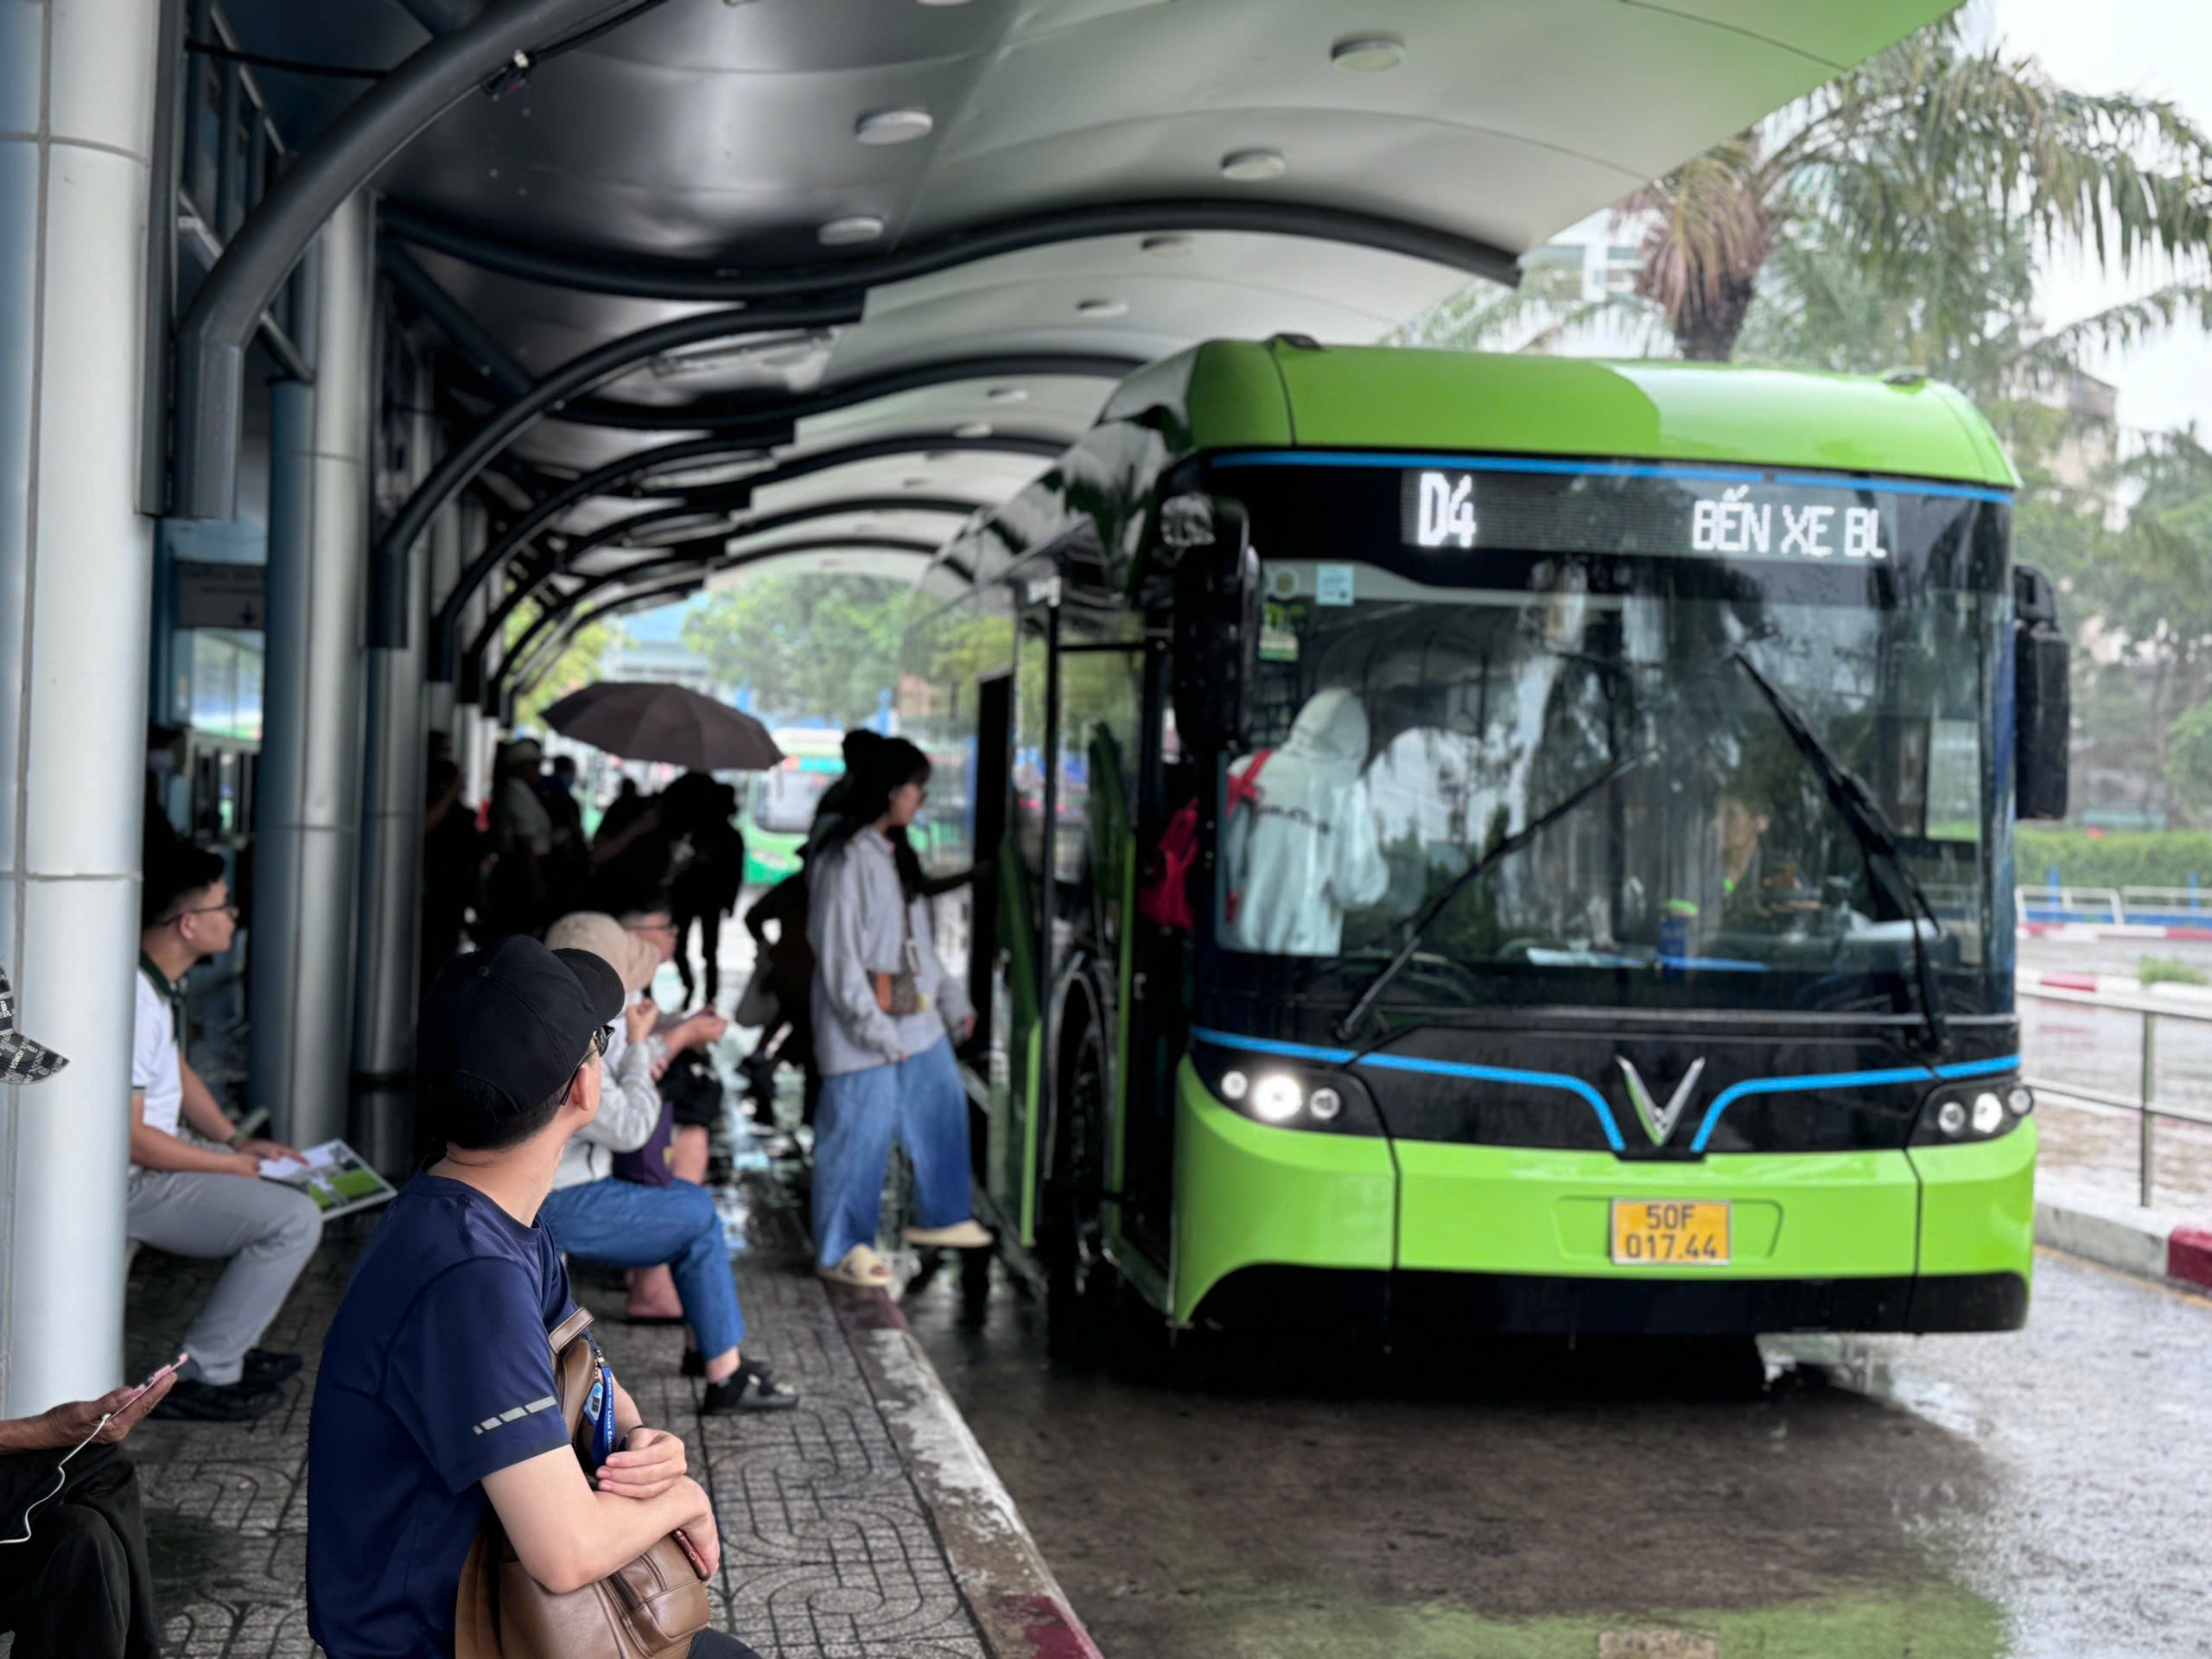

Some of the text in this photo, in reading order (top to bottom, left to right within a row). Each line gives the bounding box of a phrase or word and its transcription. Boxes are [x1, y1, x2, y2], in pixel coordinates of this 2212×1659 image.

[1418, 473, 1476, 548] D4
[1693, 485, 1770, 553] BẾN
[1780, 505, 1835, 556] XE
[1646, 1203, 1695, 1230] 50F
[1625, 1233, 1718, 1259] 017.44
